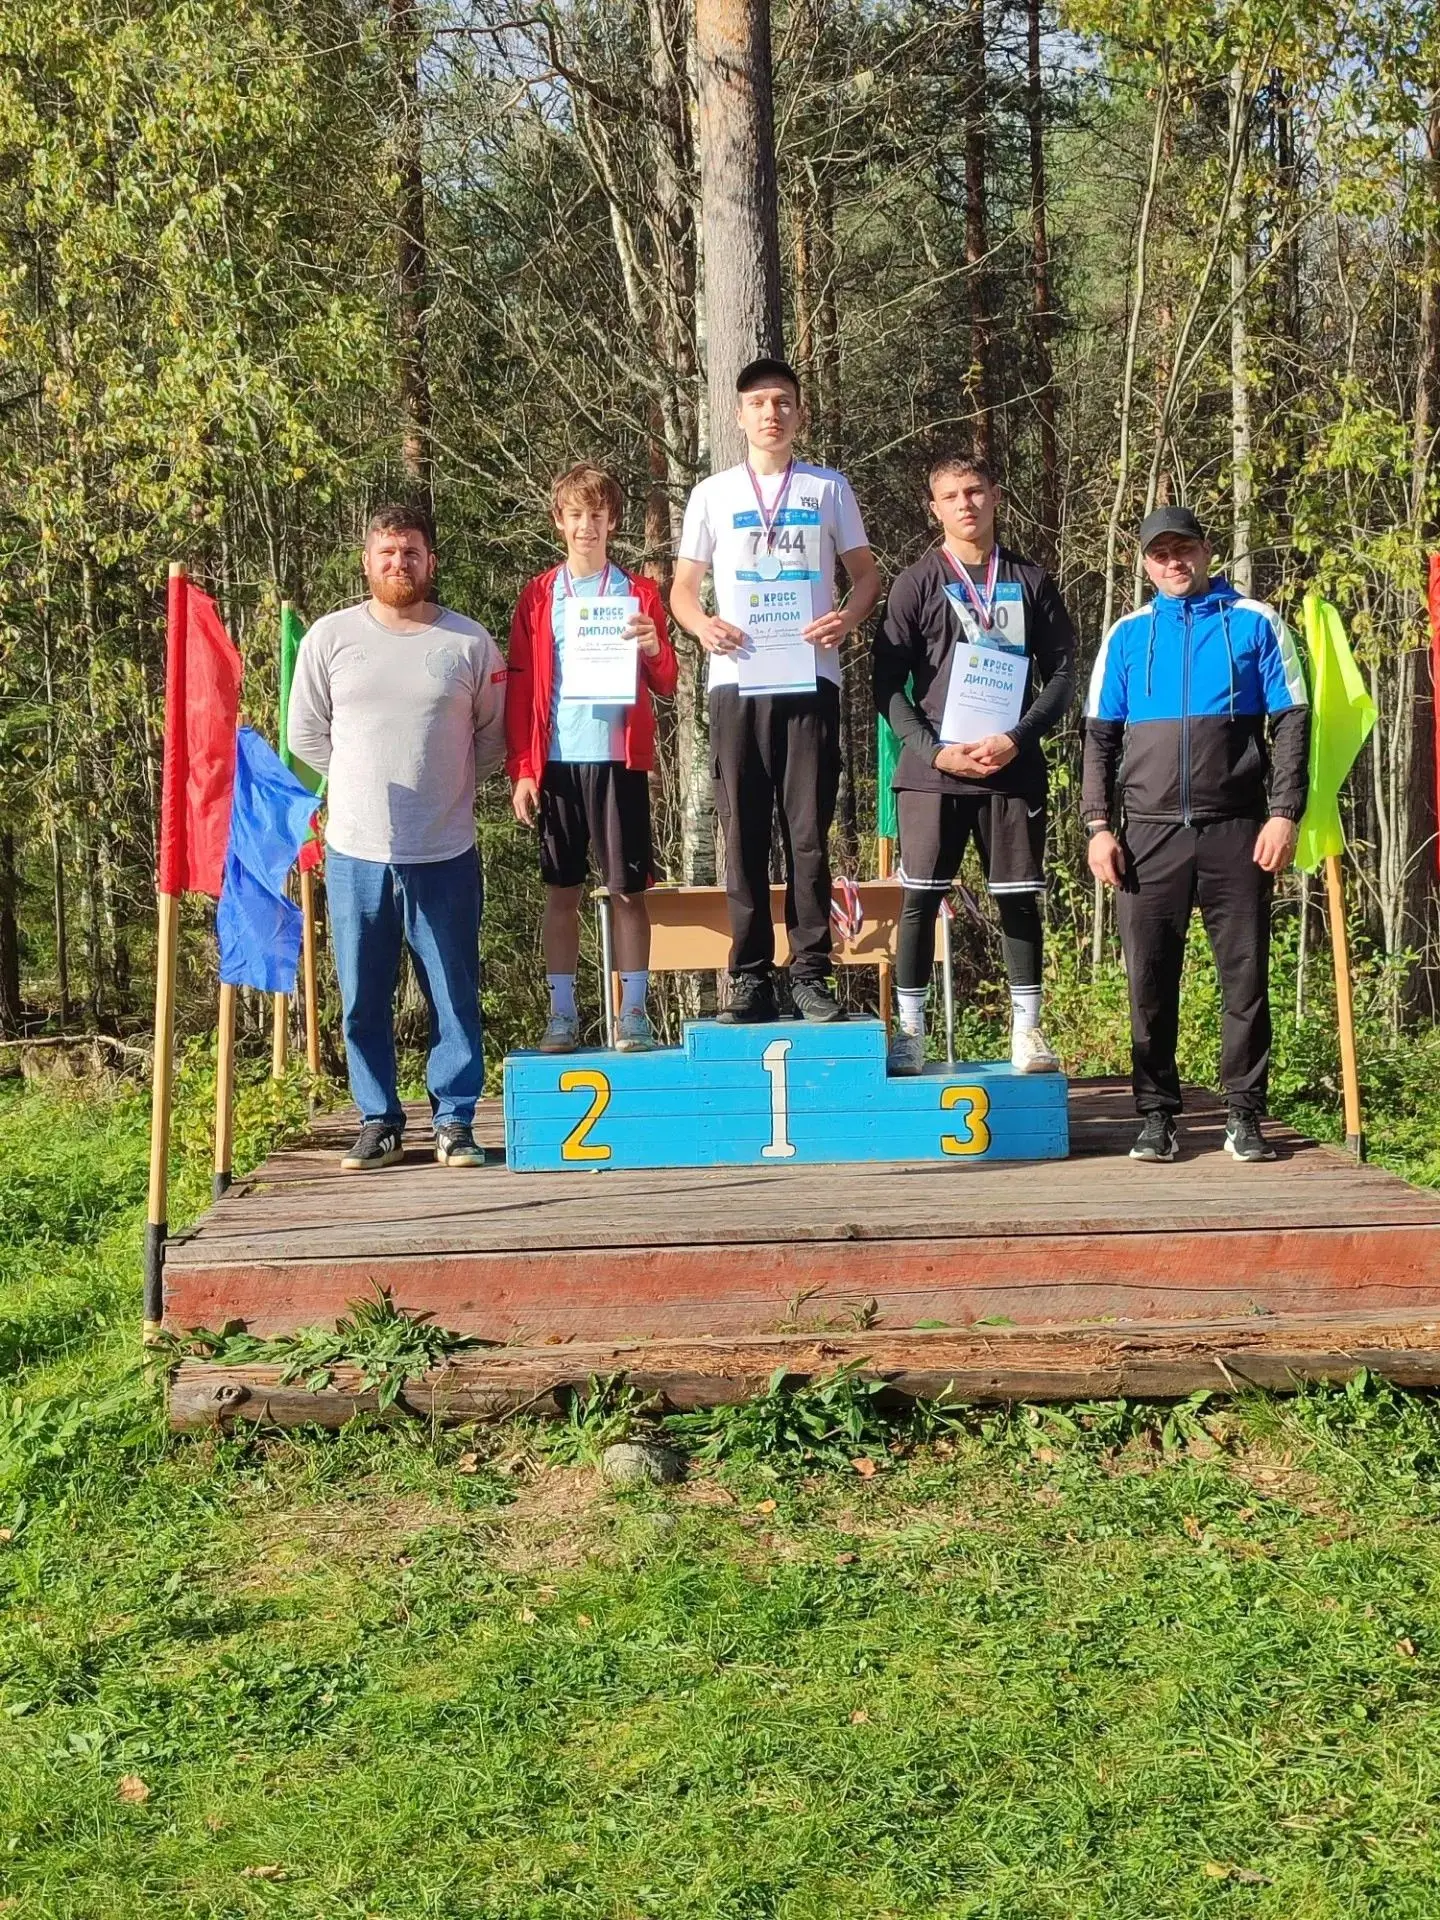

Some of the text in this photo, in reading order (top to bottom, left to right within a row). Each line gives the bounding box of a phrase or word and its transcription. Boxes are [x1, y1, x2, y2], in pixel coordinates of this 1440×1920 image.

[763, 592, 797, 602] КРОСС
[748, 611, 801, 625] ДИПЛОМ
[577, 626, 627, 637] ДИПЛОМ
[963, 673, 1014, 692] ДИПЛОМ
[761, 1039, 796, 1159] 1
[559, 1070, 611, 1161] 2
[940, 1086, 991, 1156] 3
